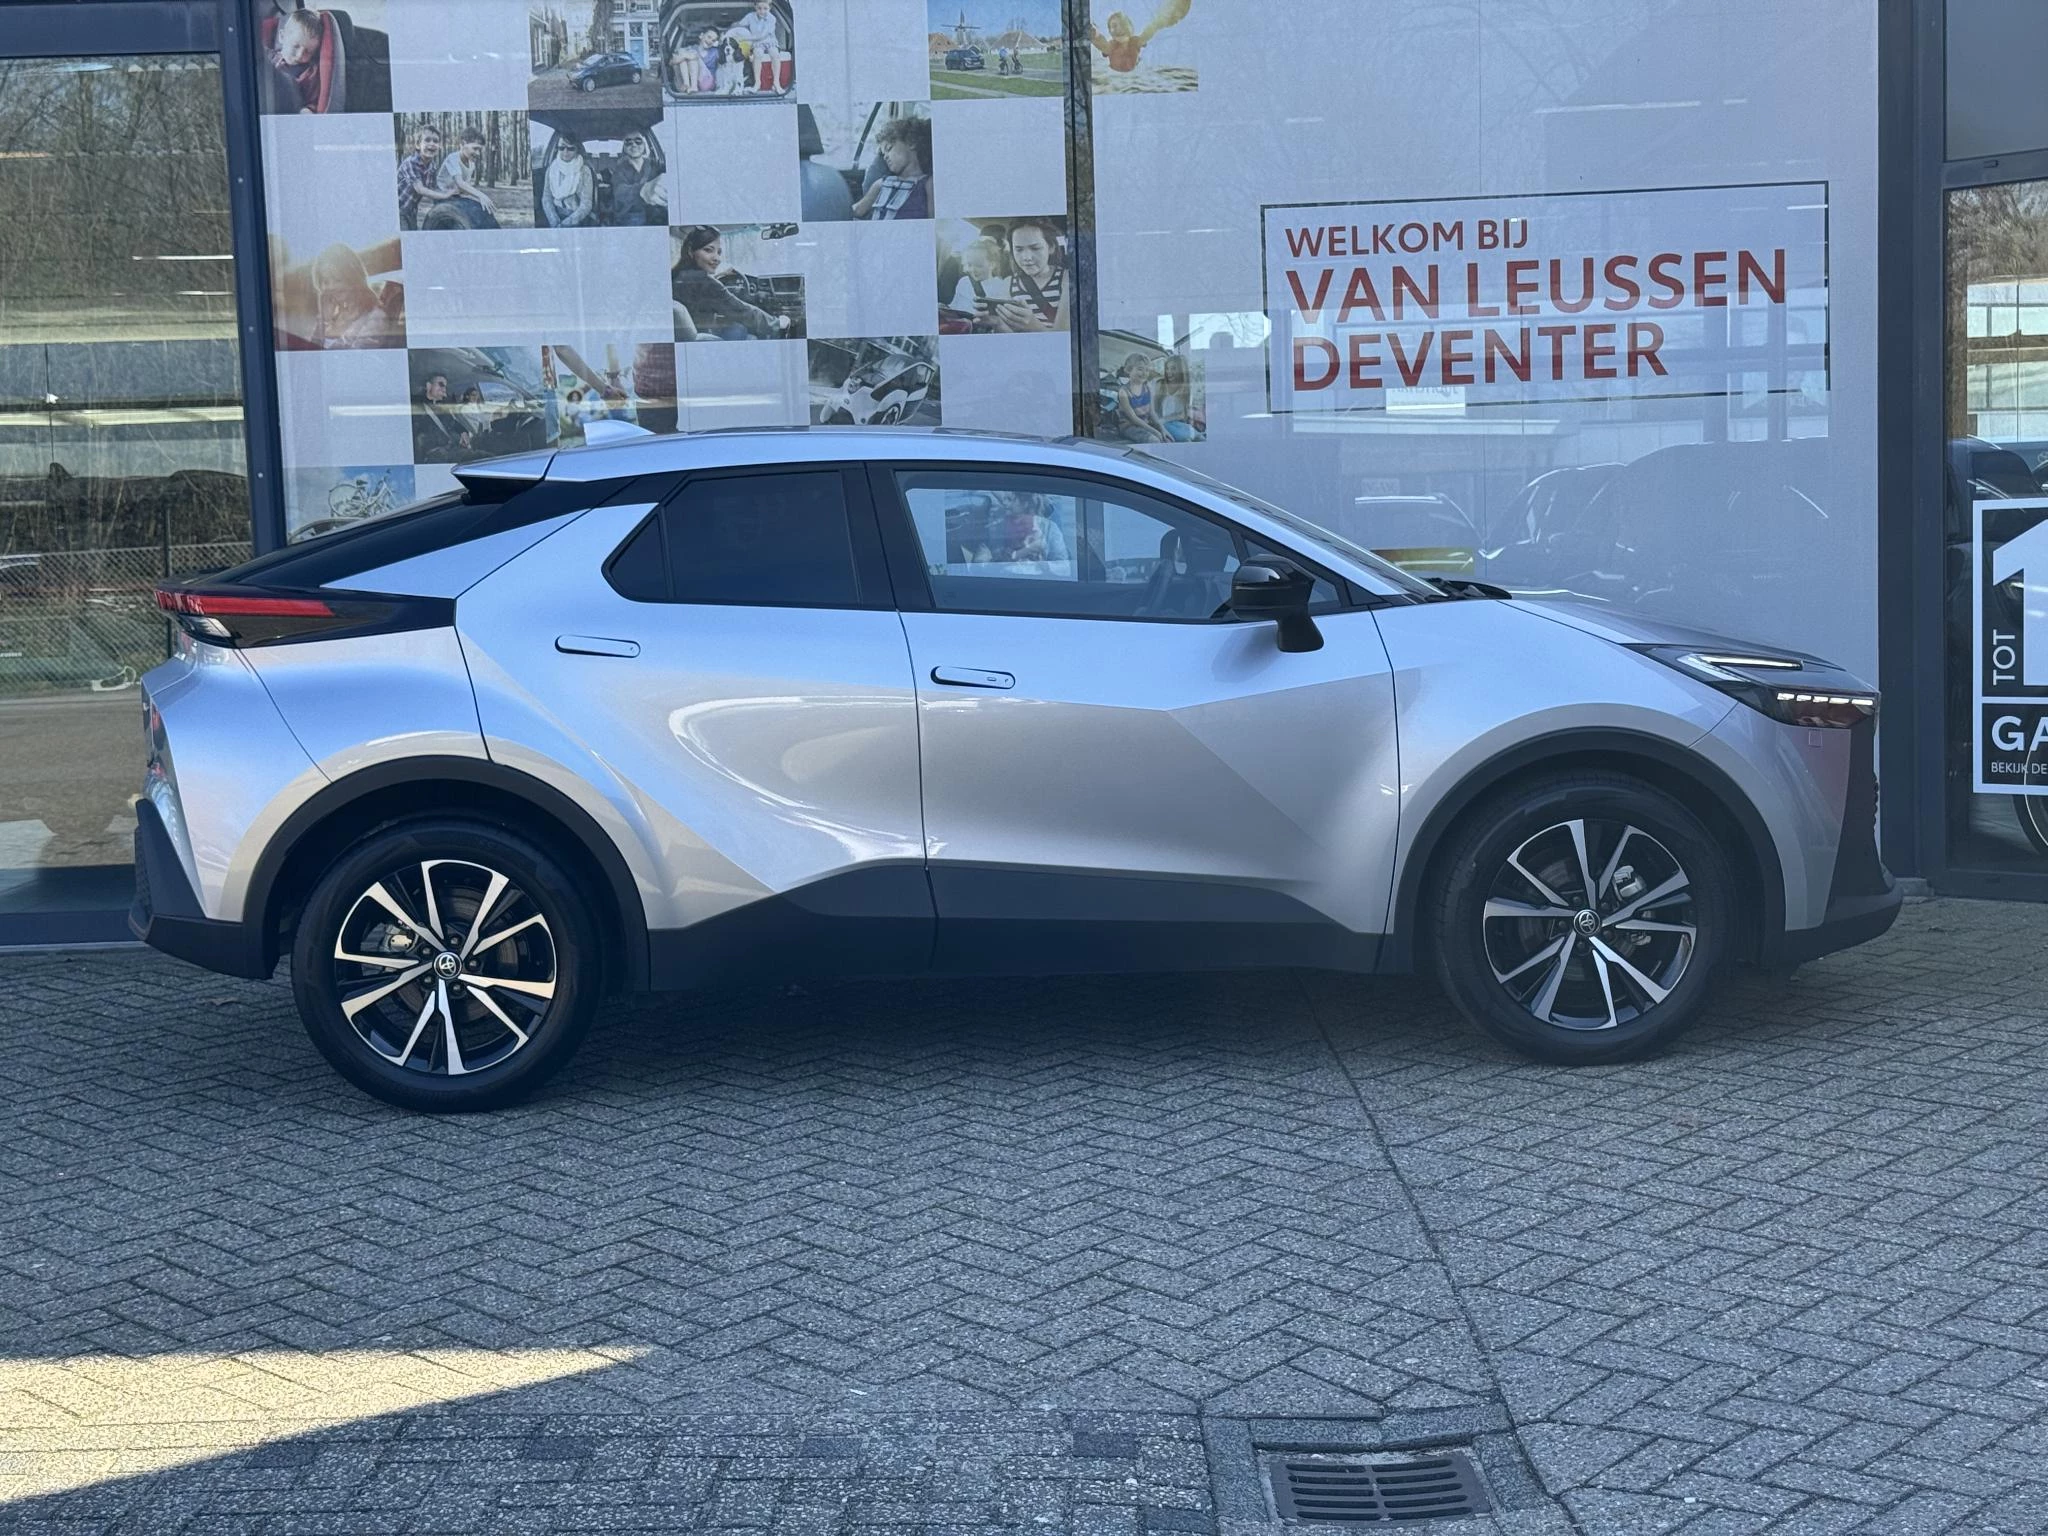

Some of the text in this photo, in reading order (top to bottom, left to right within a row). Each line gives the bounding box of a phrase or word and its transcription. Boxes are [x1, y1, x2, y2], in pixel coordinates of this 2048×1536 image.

[1286, 219, 1528, 257] WELKOM BIJ
[1286, 249, 1786, 323] VAN LEUSSEN
[1293, 323, 1669, 391] DEVENTER
[1993, 630, 2015, 686] TOT
[1991, 716, 2048, 751] GA
[1991, 762, 2048, 775] BEKIJK DE
